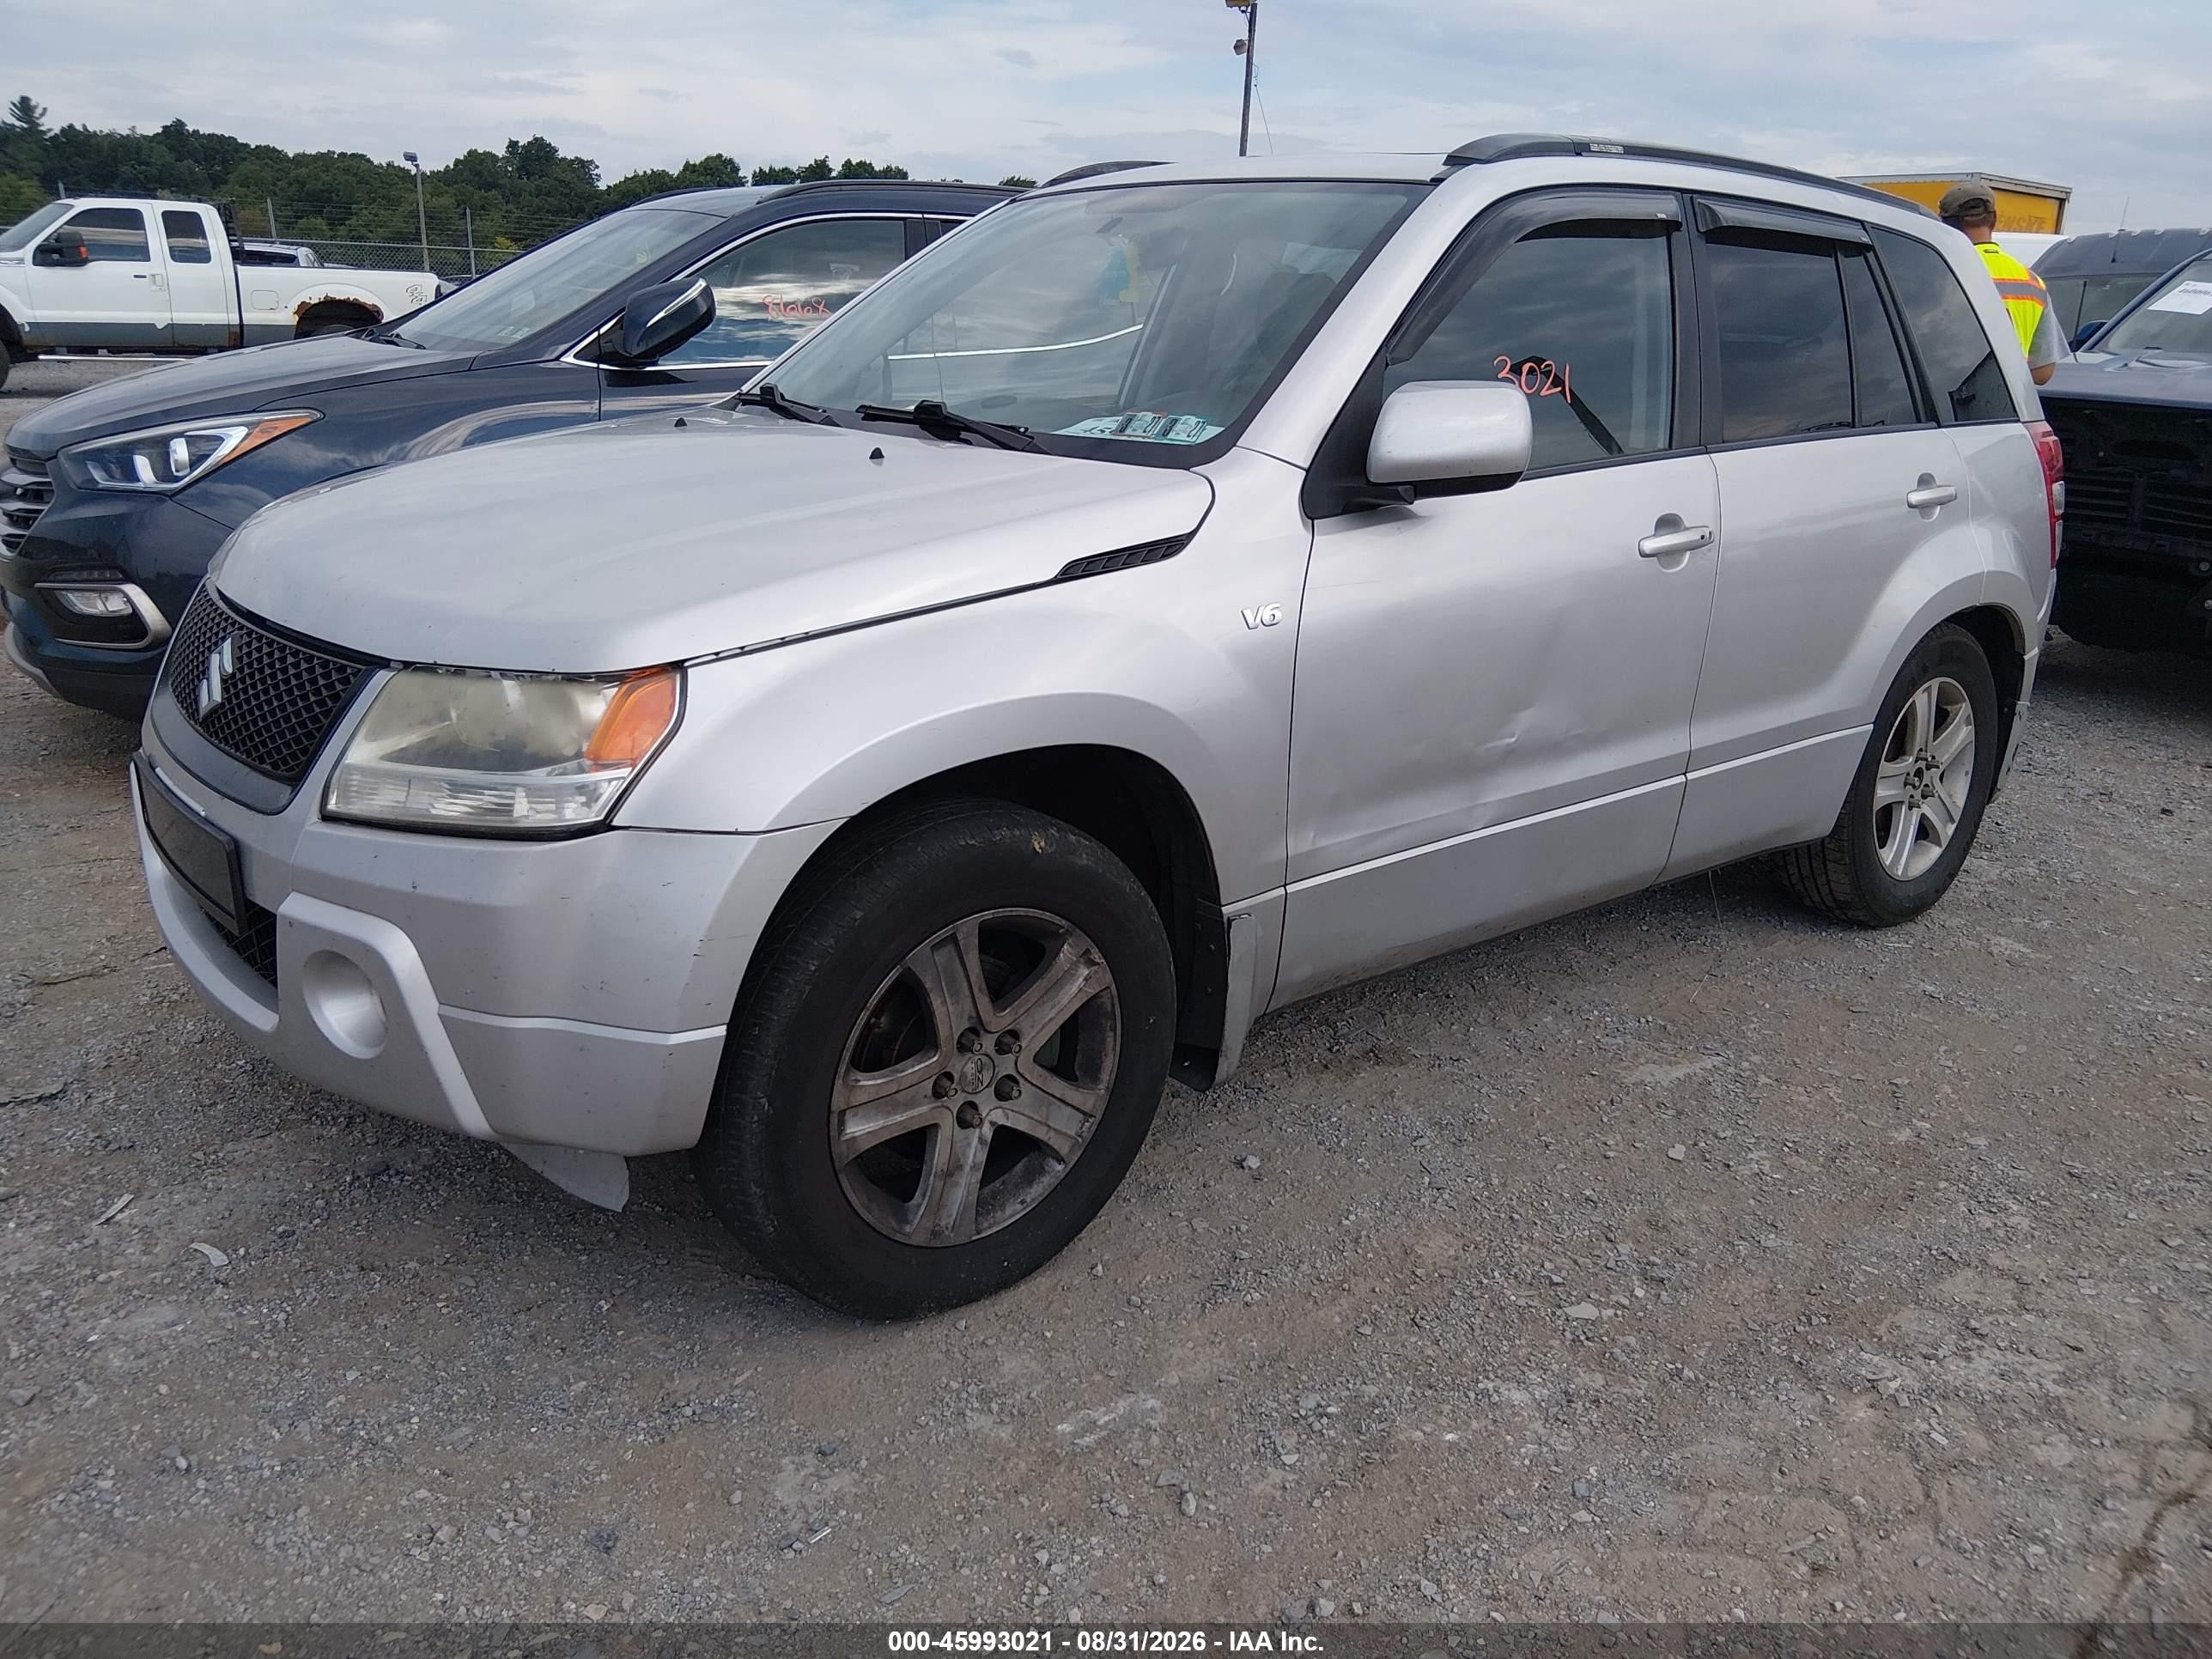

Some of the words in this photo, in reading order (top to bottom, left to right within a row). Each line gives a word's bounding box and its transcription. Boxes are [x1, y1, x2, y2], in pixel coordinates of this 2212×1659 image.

[1996, 214, 2048, 233] ENSKE
[1493, 355, 1571, 404] 3021
[1119, 416, 1133, 434] 3
[1162, 418, 1177, 437] 3
[1240, 602, 1282, 630] V6
